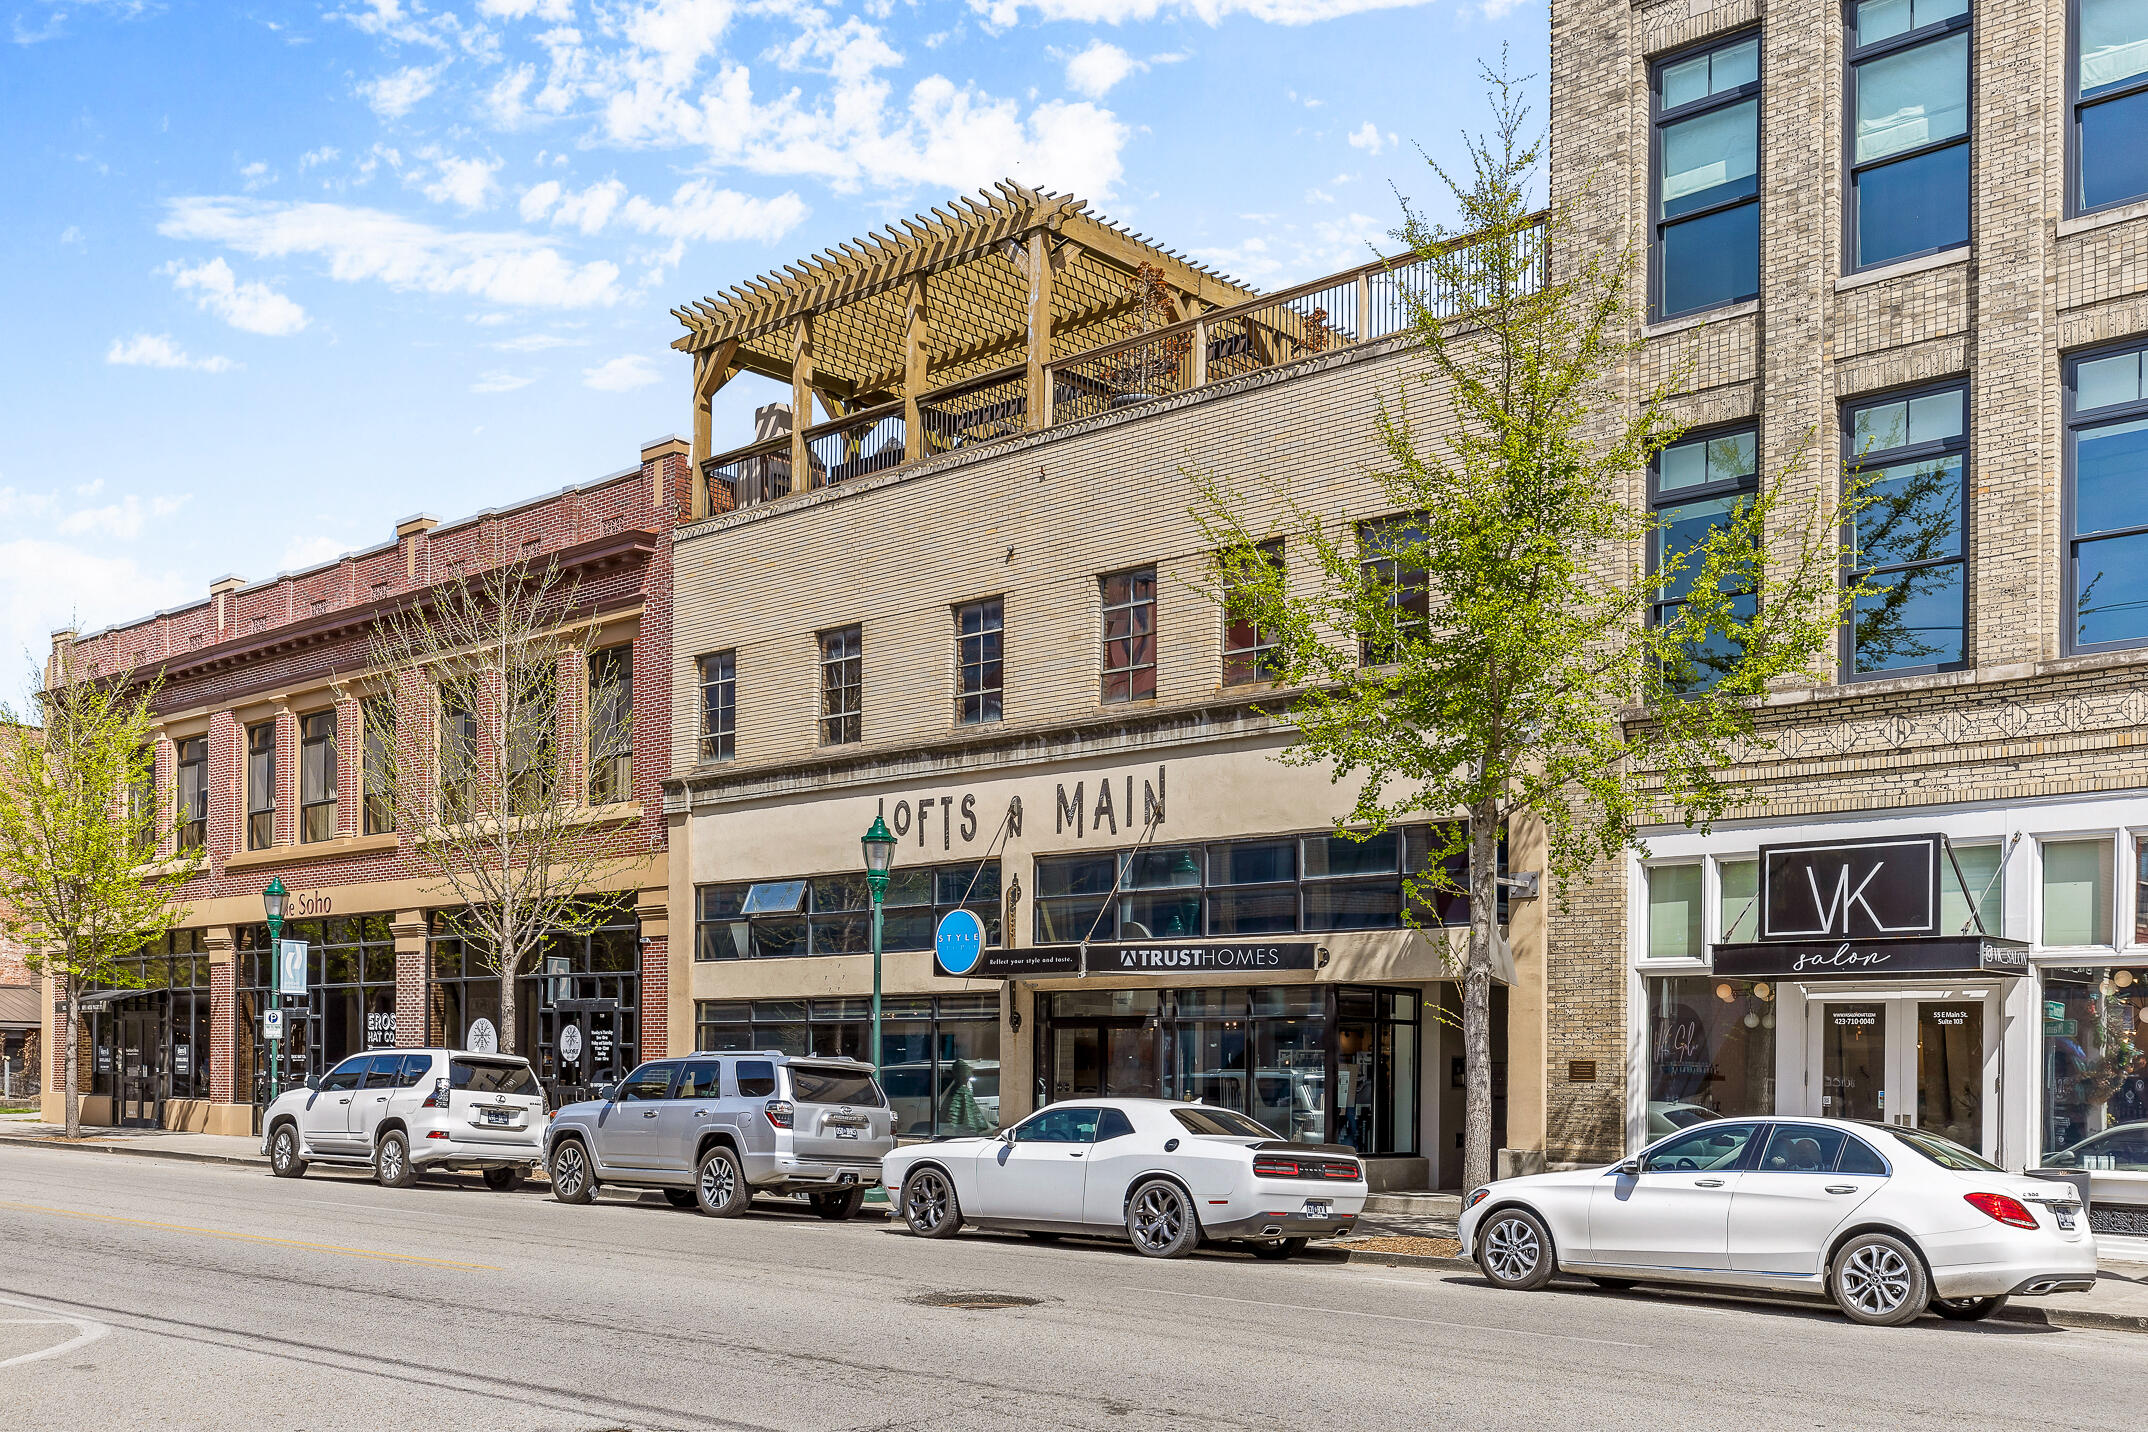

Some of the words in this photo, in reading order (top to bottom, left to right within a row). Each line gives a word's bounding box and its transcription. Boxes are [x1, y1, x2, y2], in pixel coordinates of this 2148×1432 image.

[1056, 764, 1166, 838] MAIN
[298, 890, 332, 916] Soho
[1806, 861, 1884, 934] VK
[938, 933, 979, 943] STYLE
[1026, 957, 1041, 965] style
[1793, 942, 1891, 971] salon
[270, 1013, 277, 1023] P
[368, 1031, 382, 1043] HAT
